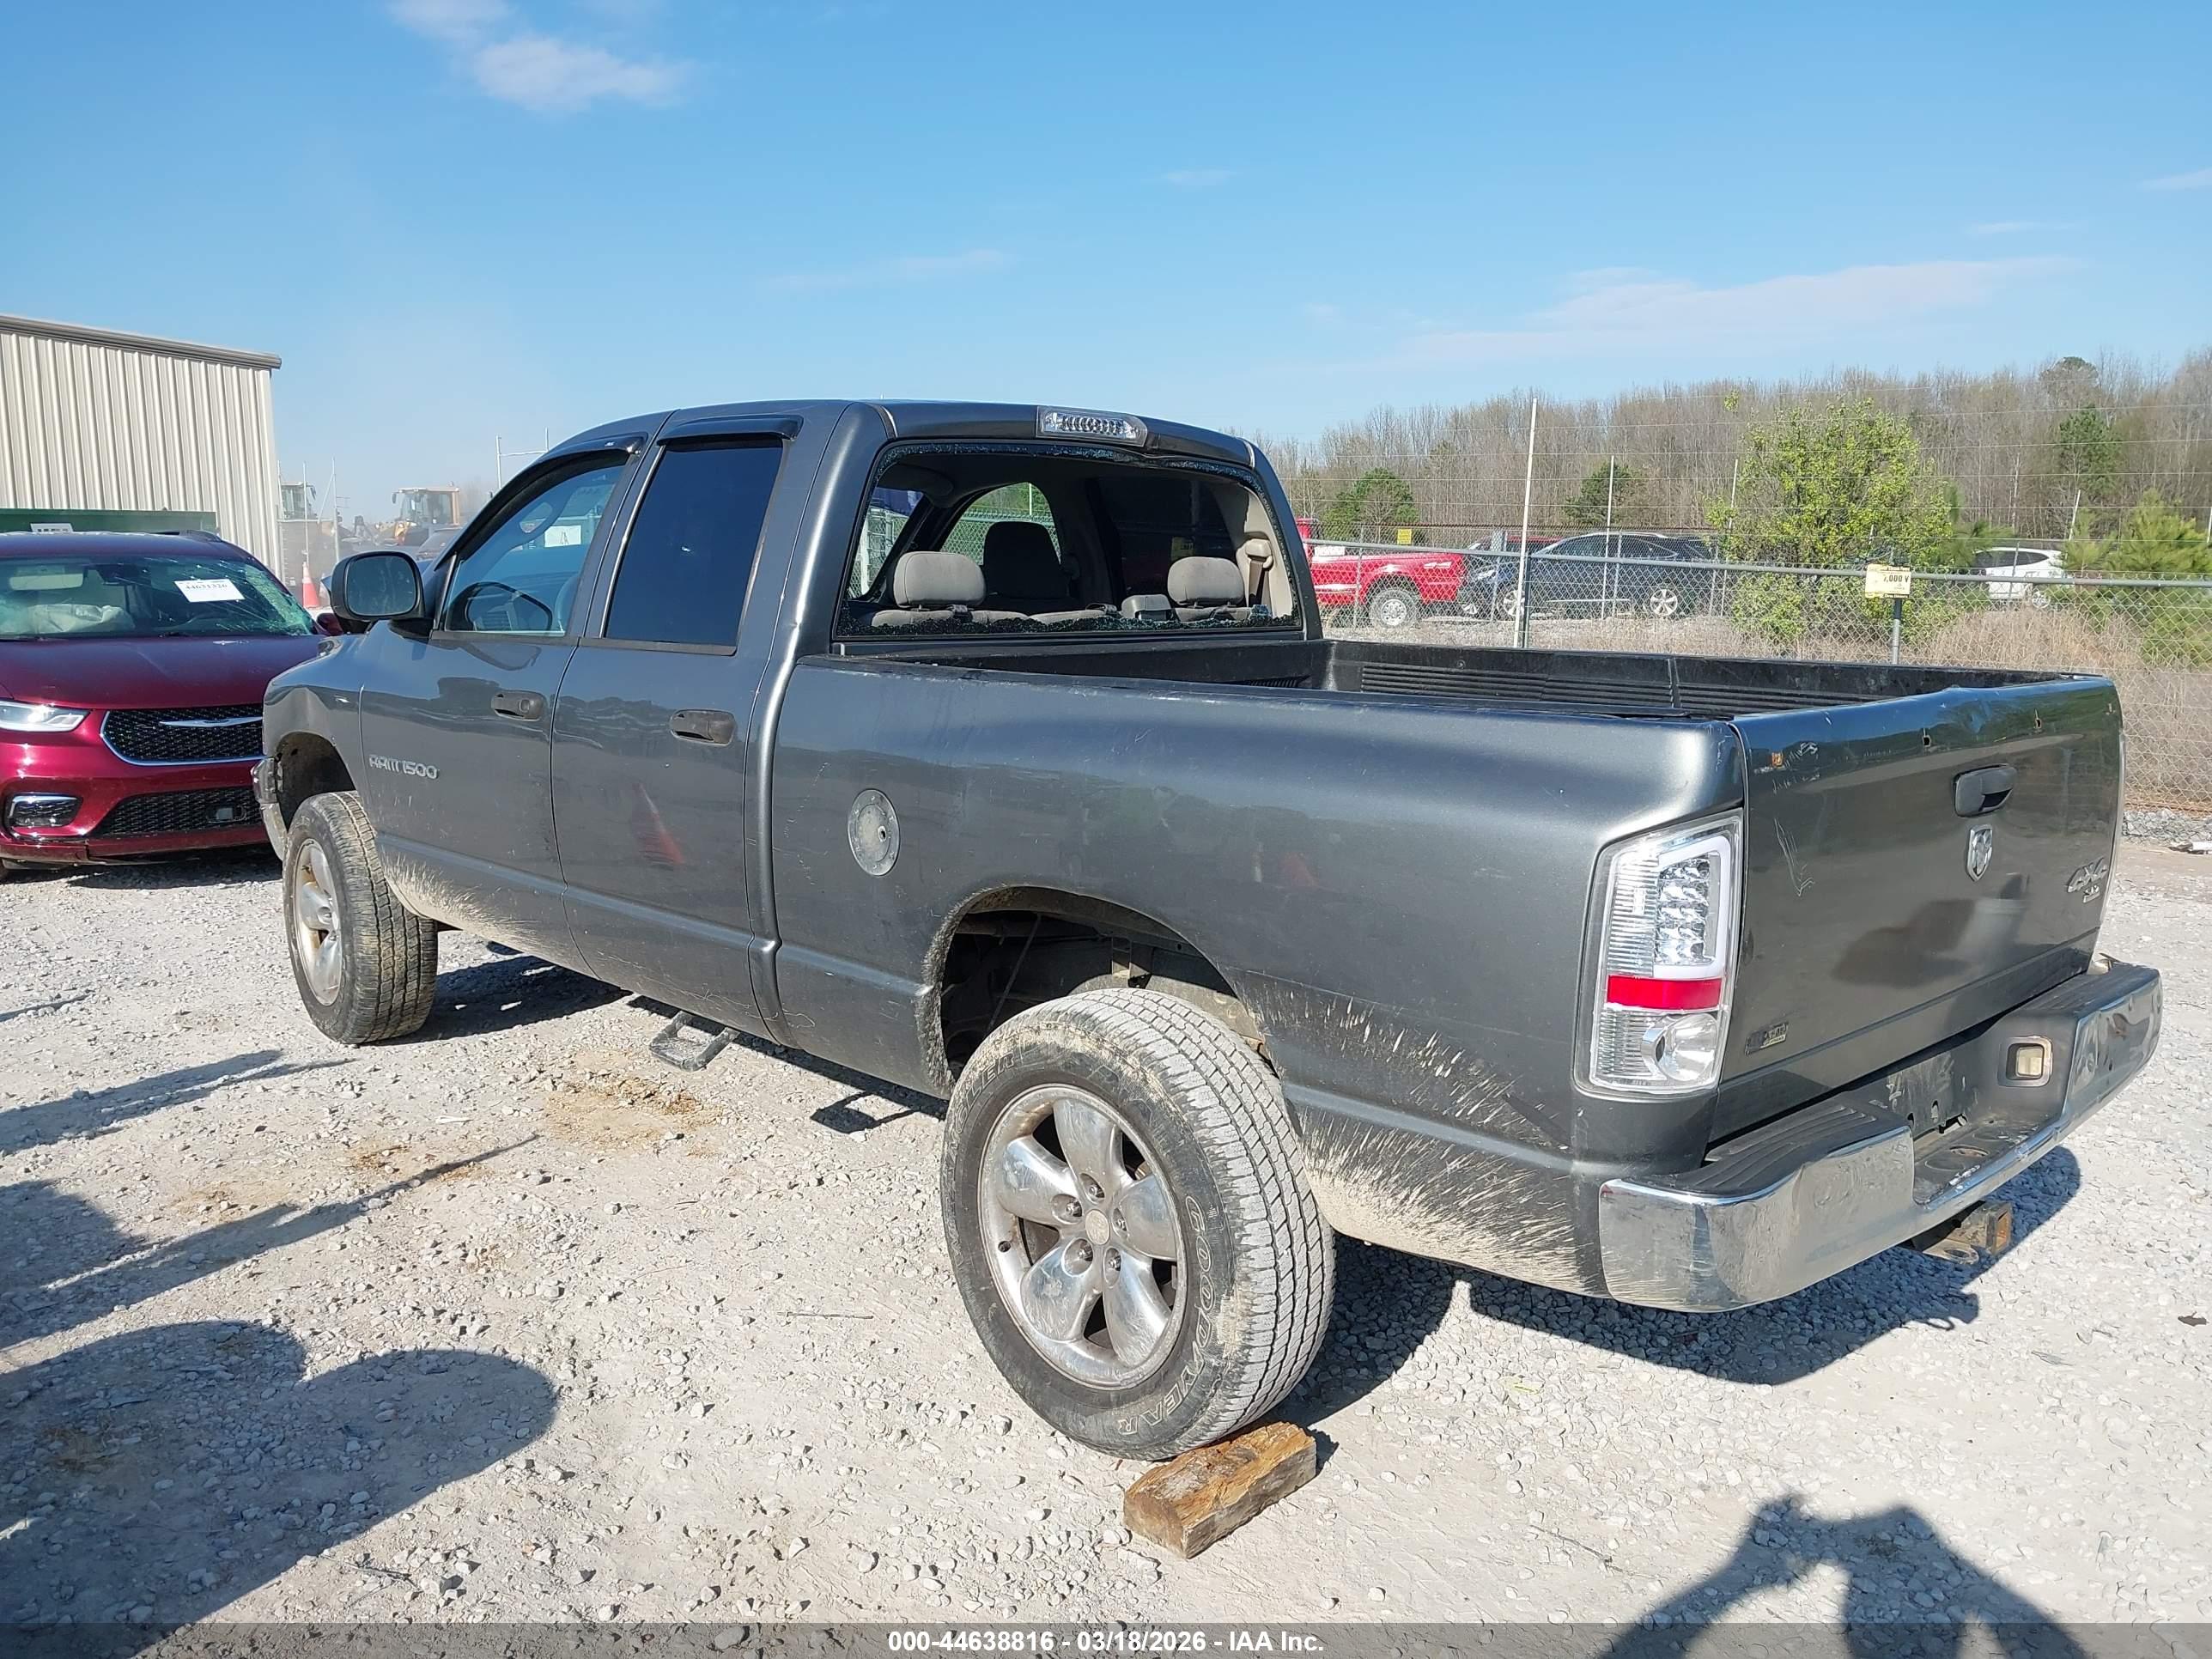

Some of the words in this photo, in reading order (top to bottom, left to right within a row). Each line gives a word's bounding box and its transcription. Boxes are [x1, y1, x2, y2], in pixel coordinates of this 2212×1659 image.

[1882, 574, 1903, 583] 7,000
[368, 754, 399, 772] RAM
[402, 761, 437, 779] 1500
[1117, 1195, 1215, 1436] GOODYEAR
